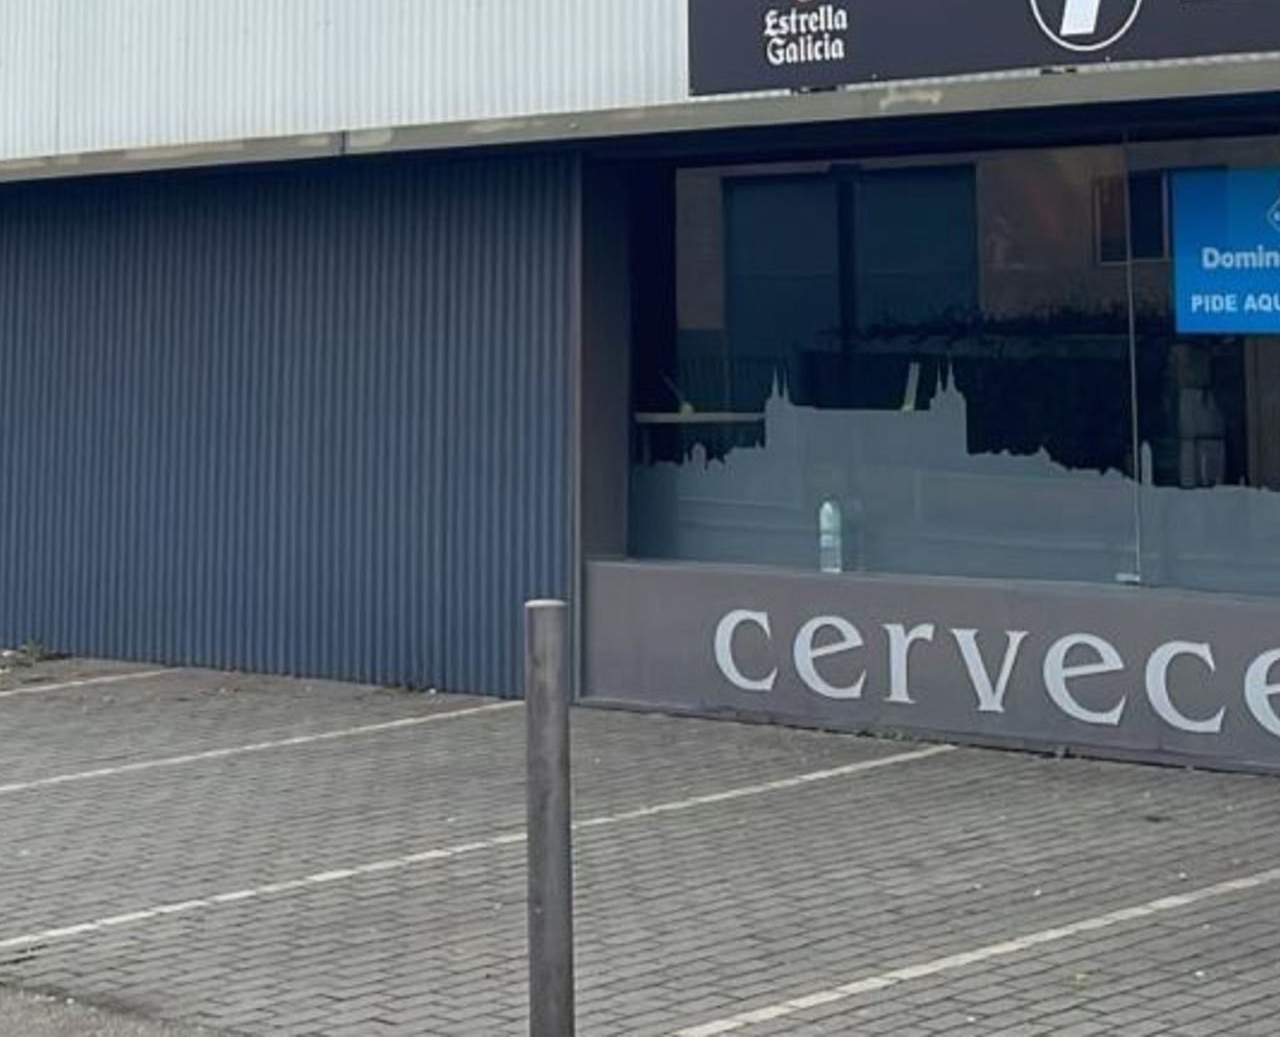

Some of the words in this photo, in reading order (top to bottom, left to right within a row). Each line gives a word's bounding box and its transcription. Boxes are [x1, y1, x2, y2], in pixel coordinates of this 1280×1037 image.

[763, 4, 848, 36] Estrella
[766, 34, 846, 66] Galicia
[1191, 293, 1238, 313] PIDE
